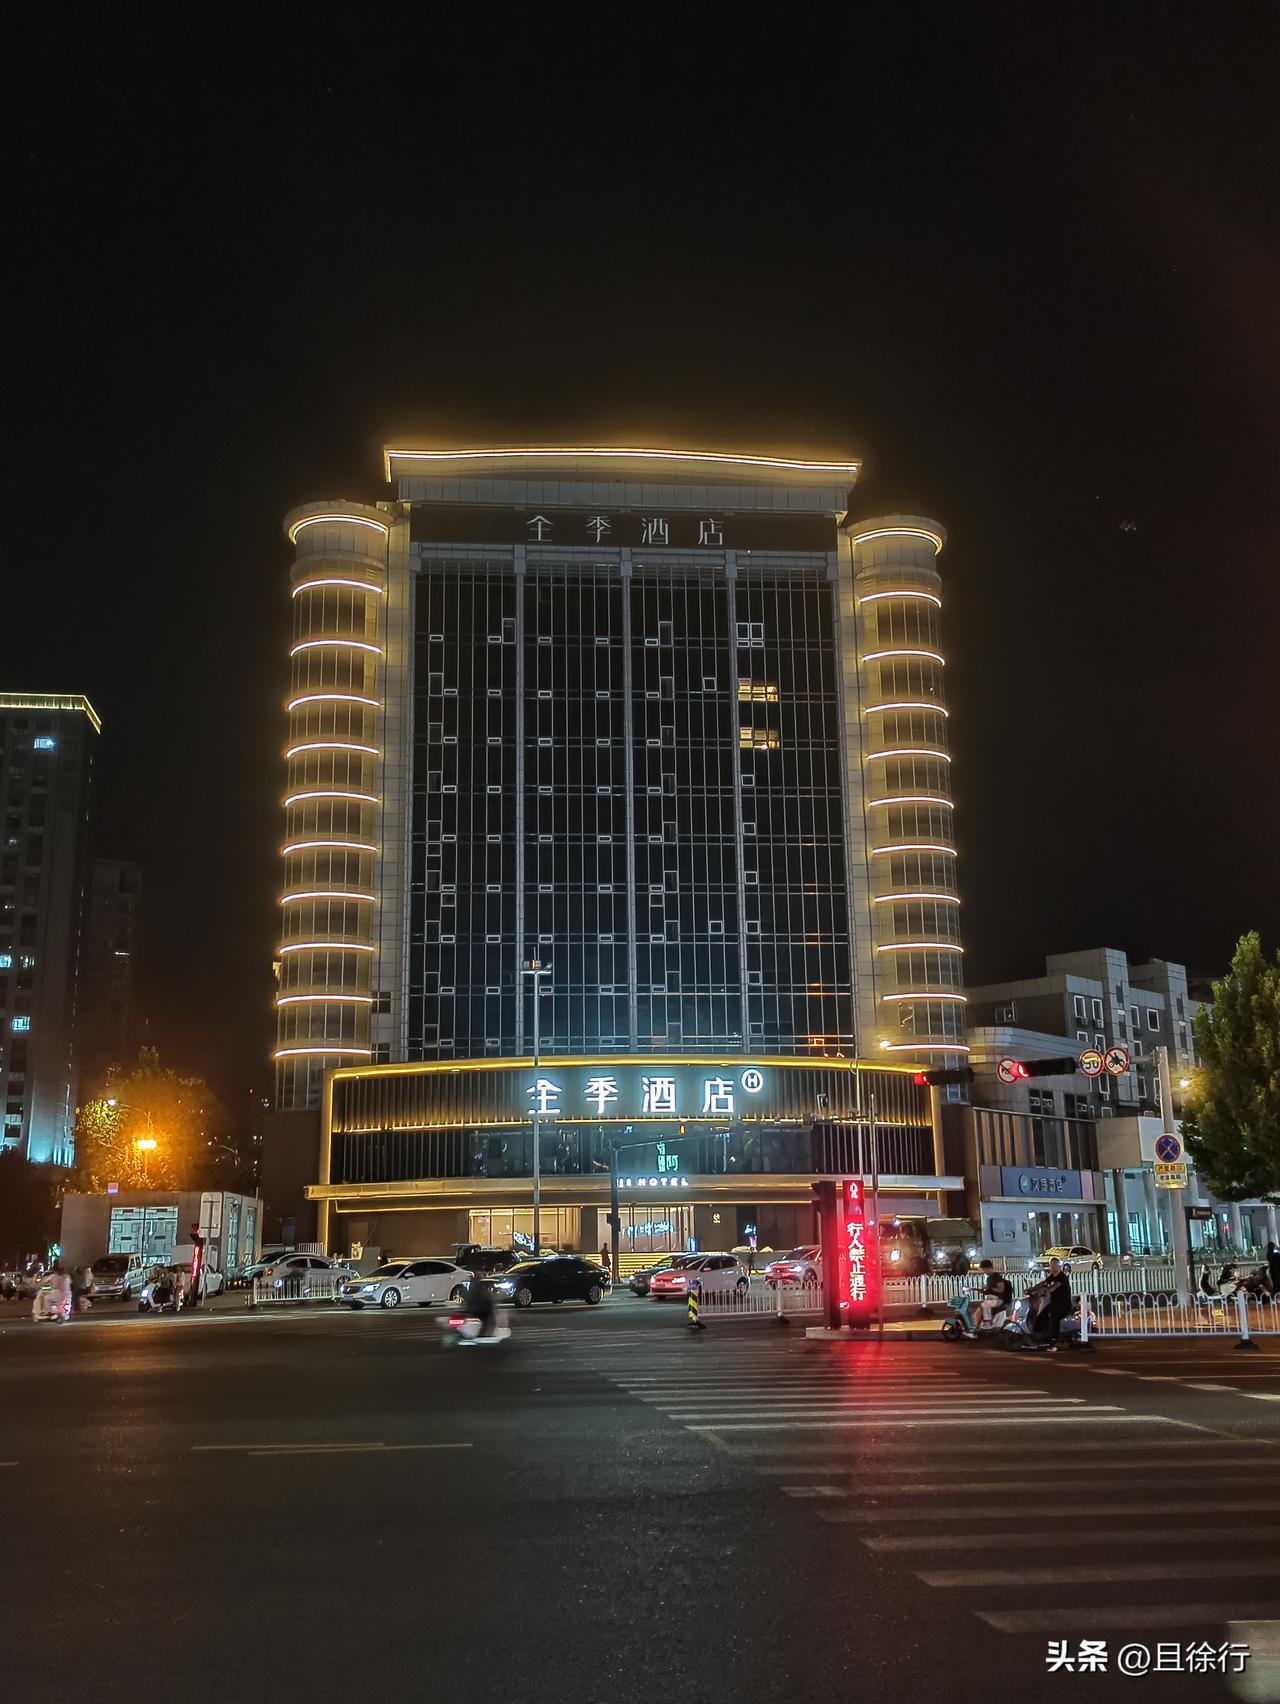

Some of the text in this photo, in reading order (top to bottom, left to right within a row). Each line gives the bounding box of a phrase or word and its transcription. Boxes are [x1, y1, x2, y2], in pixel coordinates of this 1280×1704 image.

[526, 515, 725, 545] 全季酒店
[526, 1076, 735, 1114] 全季酒店
[637, 1176, 689, 1187] HOTEL
[847, 1222, 866, 1301] 行人禁止通行
